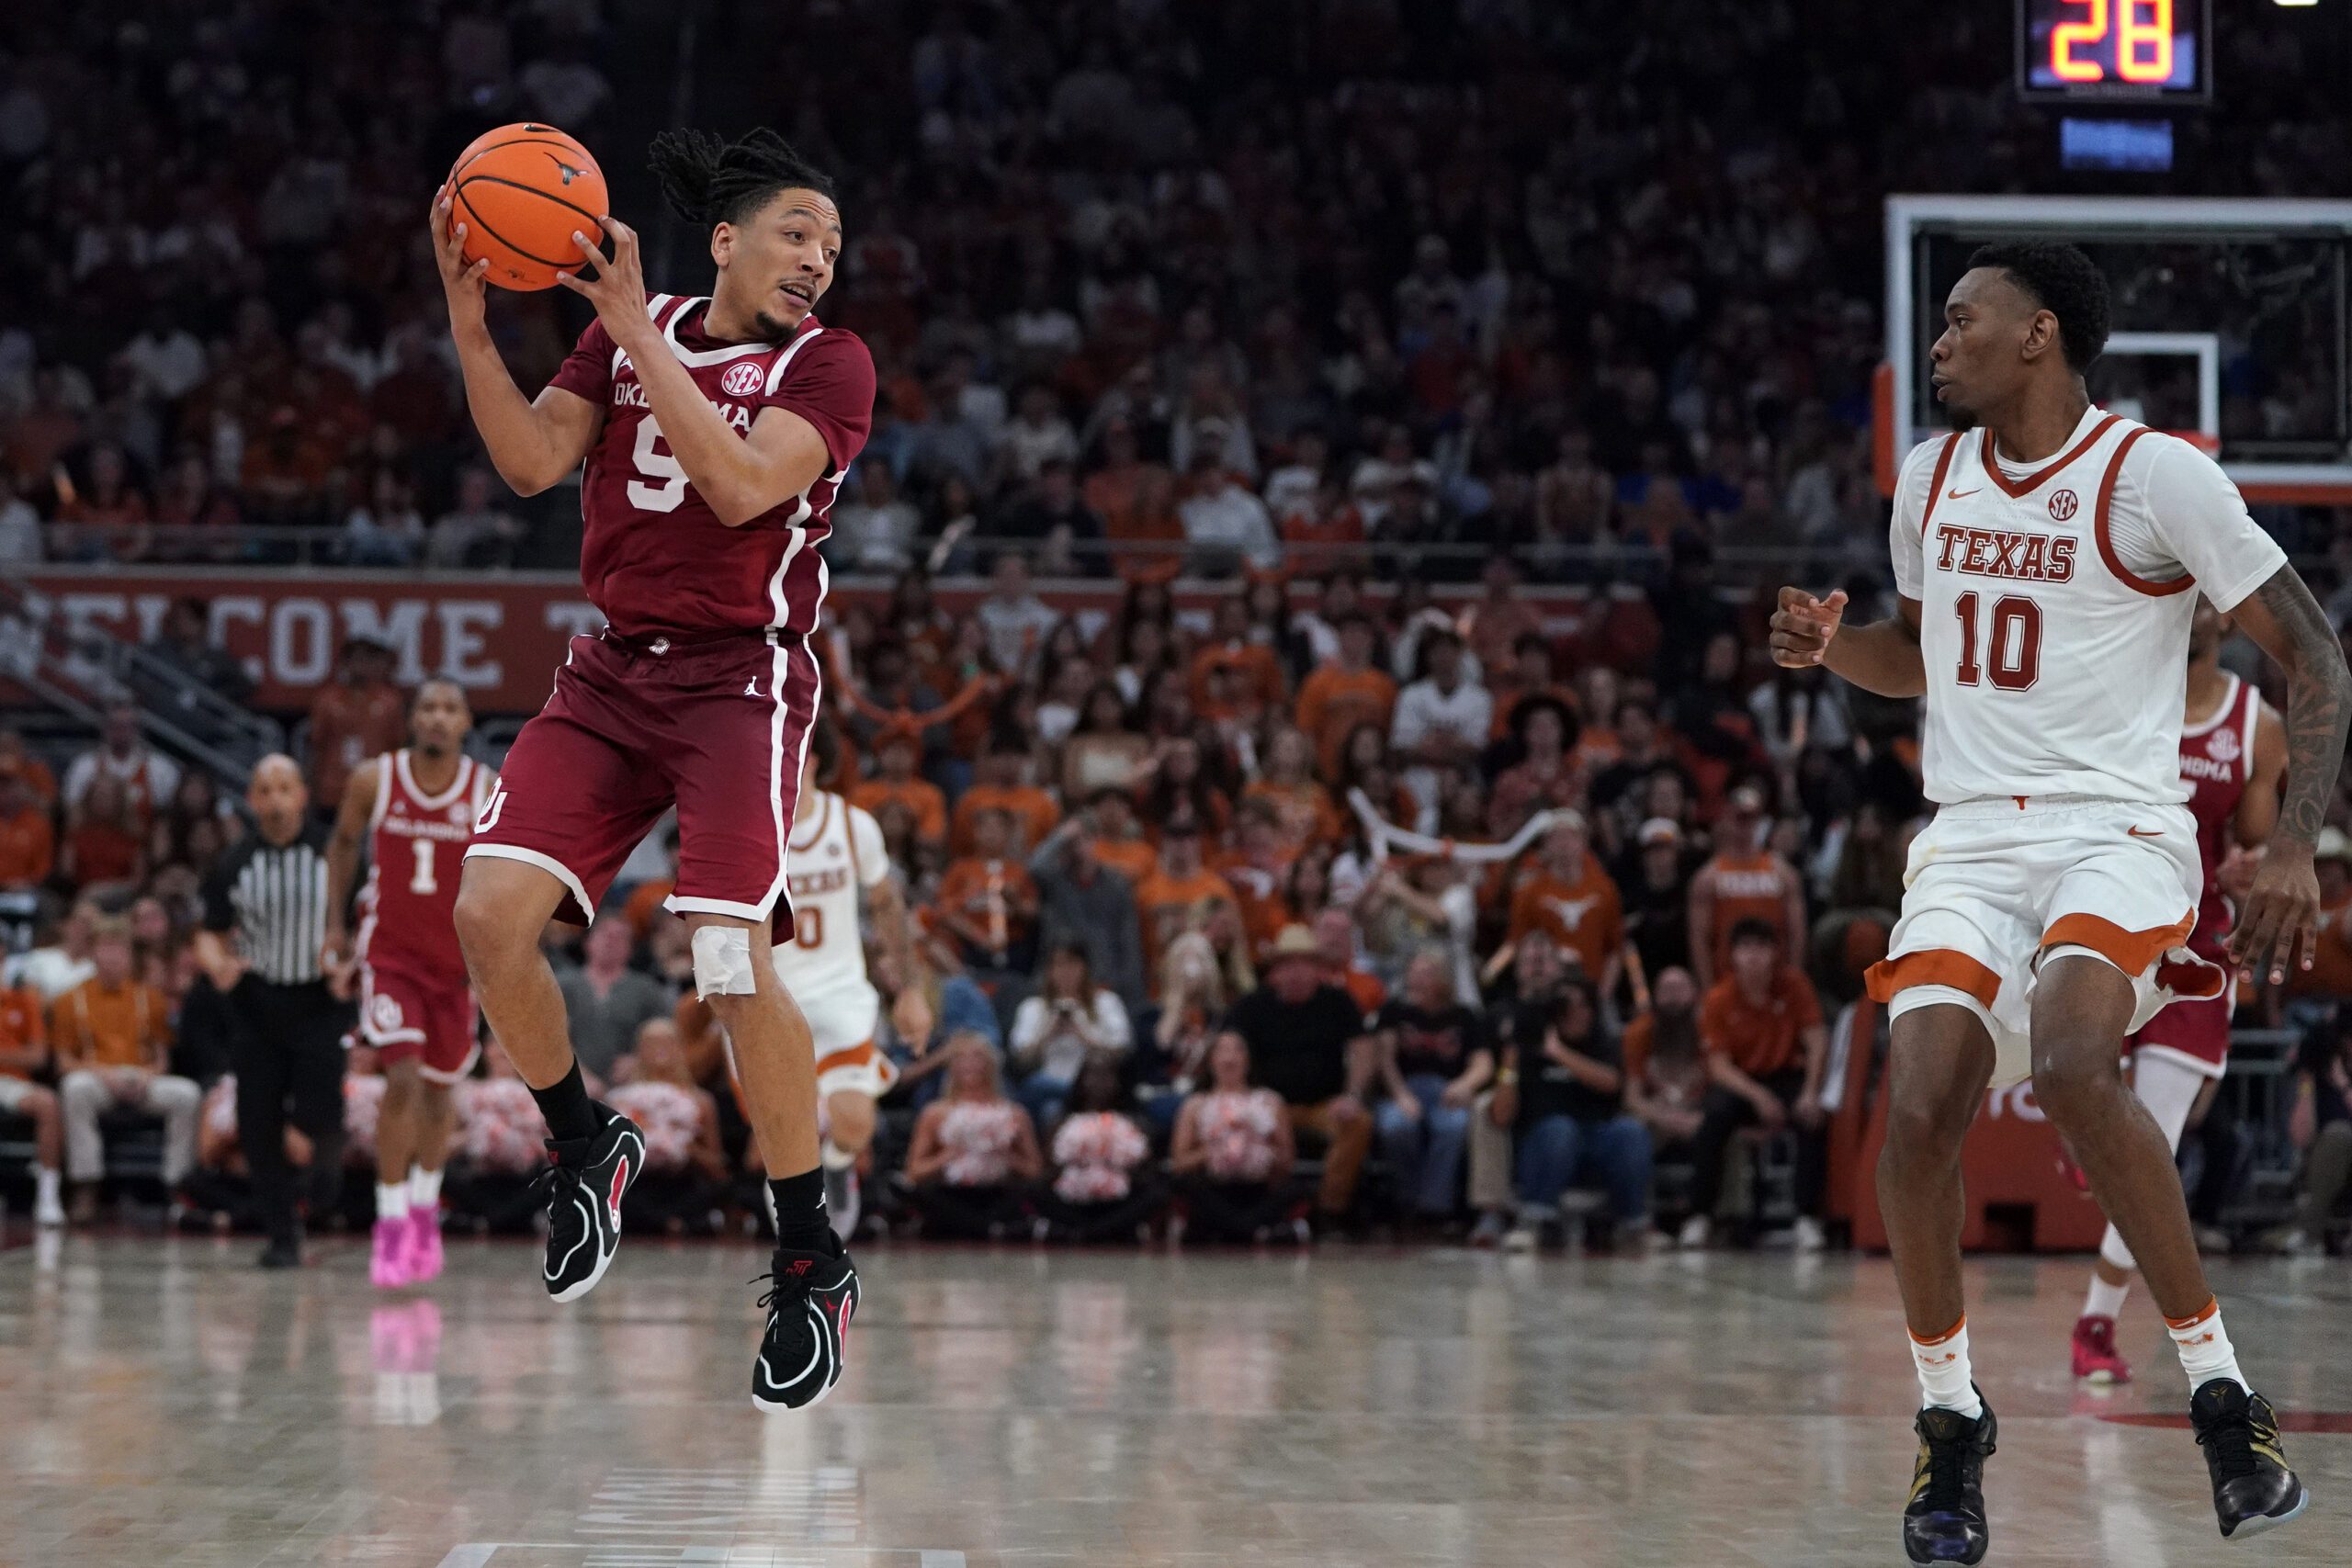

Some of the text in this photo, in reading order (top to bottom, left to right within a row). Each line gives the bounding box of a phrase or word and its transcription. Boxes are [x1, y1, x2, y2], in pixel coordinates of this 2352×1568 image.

[2049, 0, 2174, 83] 28
[614, 382, 752, 433] OKLMA
[724, 365, 762, 394] SEC
[627, 413, 689, 513] 9
[2050, 491, 2077, 519] SEC
[1936, 523, 2077, 583] TEXAS
[1954, 591, 2042, 692] 10
[410, 838, 439, 896] 1
